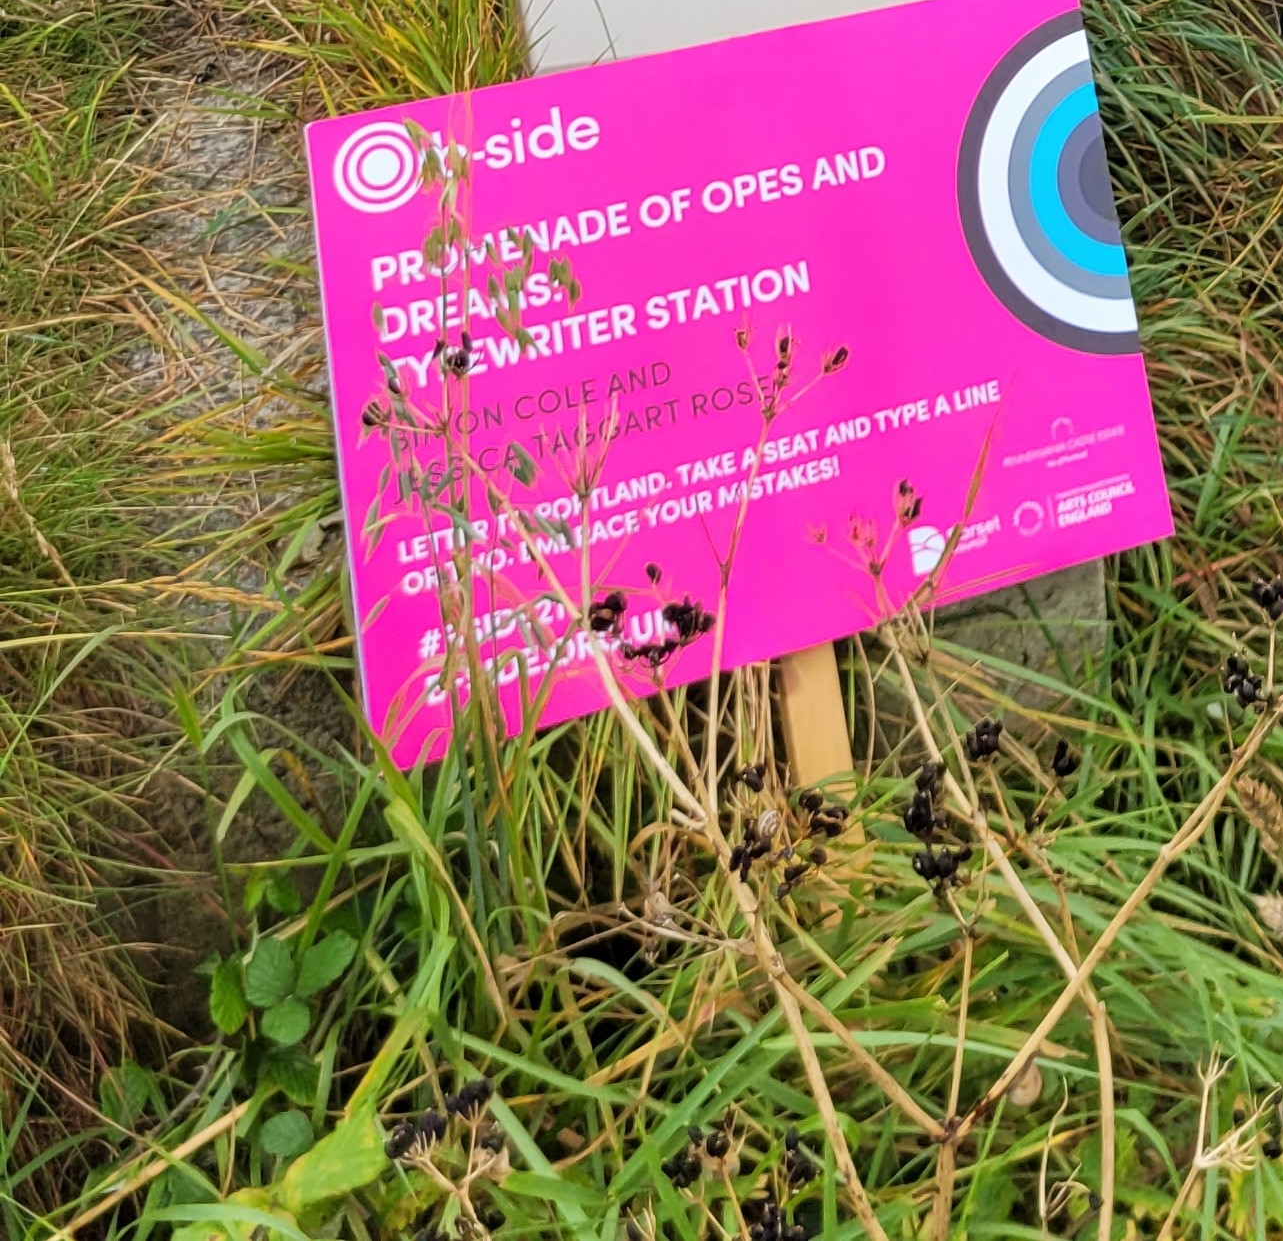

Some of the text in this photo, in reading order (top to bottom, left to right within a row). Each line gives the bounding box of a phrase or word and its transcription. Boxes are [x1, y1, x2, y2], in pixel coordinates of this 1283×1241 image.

[371, 146, 886, 292] PROMENADE OF OPES AND
[382, 259, 810, 389] TYEWRITER STATION
[514, 379, 599, 420] COLE
[607, 361, 672, 399] AND
[531, 399, 680, 459] TAGGART
[676, 451, 737, 487] TAKE
[741, 447, 758, 466] A
[762, 429, 820, 464] SEAT
[824, 417, 872, 448] AND
[874, 399, 931, 433] TYPE
[934, 395, 951, 418] A
[953, 380, 1001, 412] LINE
[642, 490, 713, 528] YOUR
[717, 455, 840, 509] MISTAKES!
